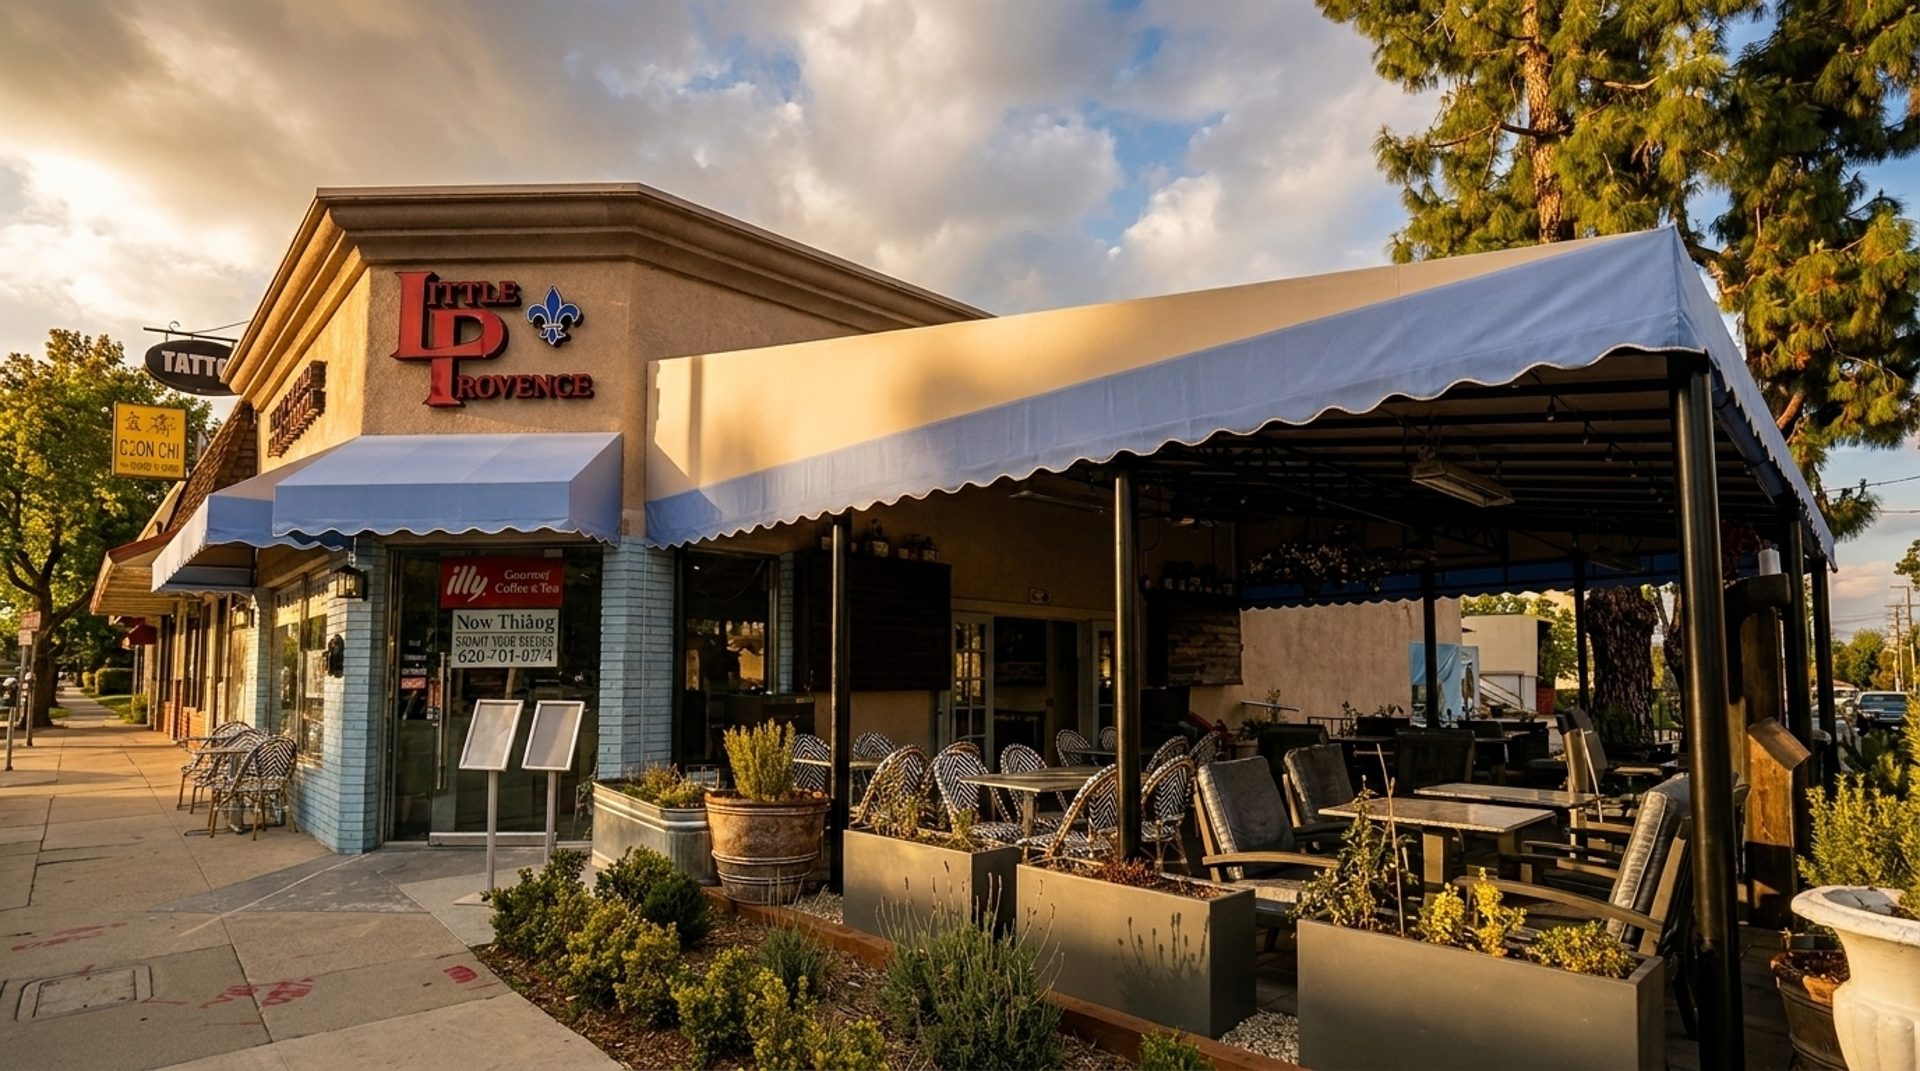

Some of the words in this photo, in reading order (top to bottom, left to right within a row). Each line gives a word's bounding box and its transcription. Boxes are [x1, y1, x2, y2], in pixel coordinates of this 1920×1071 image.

[158, 442, 180, 460] CHI
[540, 582, 560, 594] Tea
[456, 614, 493, 630] Now
